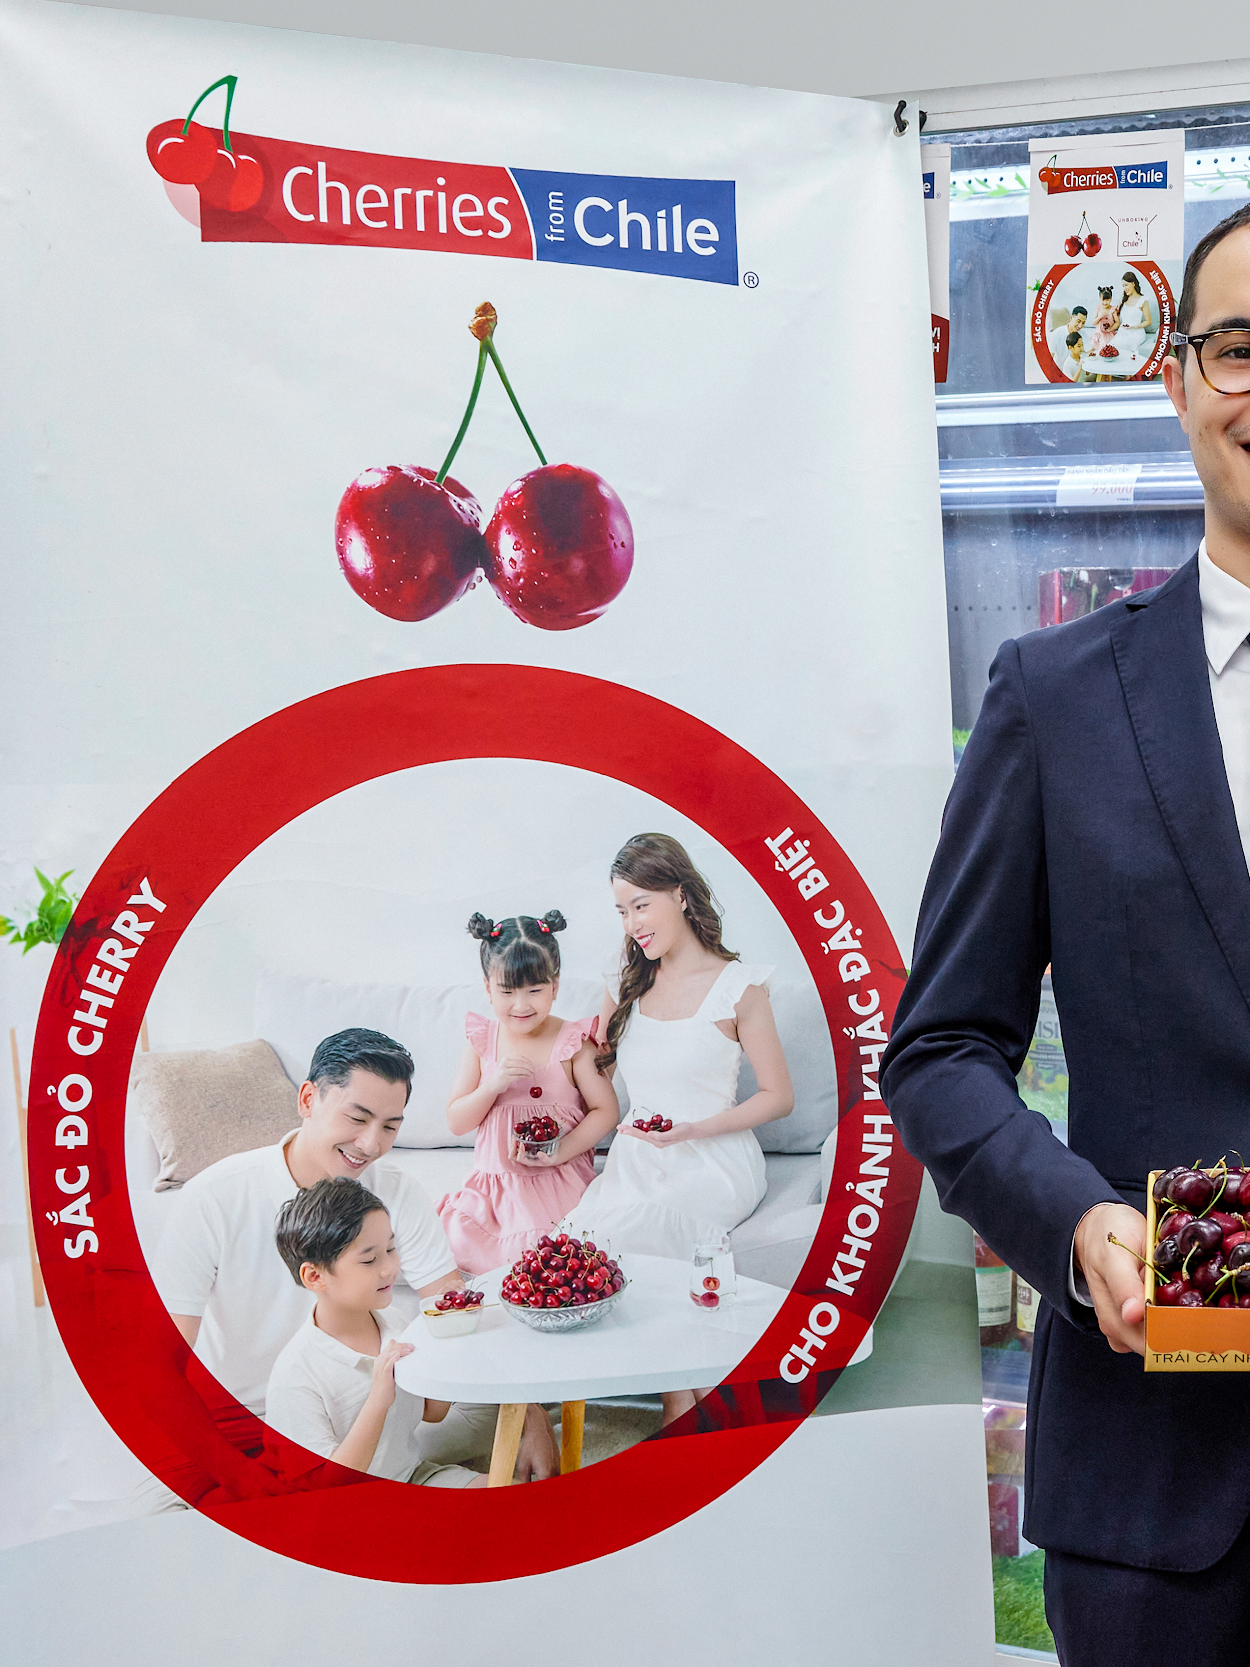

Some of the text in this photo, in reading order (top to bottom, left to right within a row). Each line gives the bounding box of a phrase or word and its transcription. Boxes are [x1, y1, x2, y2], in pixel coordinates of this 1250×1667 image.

[1064, 170, 1114, 188] Cherries
[1126, 168, 1164, 184] Chile
[282, 161, 720, 256] Cherries from Chile
[1122, 240, 1138, 248] Chile
[1038, 280, 1054, 310] CHERRY
[1144, 361, 1158, 378] CHO
[46, 876, 168, 1259] SẮC ĐỎ CHERRY
[764, 826, 893, 1384] CHO KHOẢNH KHẮC ĐẶC BIỆT
[1152, 1351, 1190, 1364] TRÁI
[1196, 1351, 1229, 1364] CÂY
